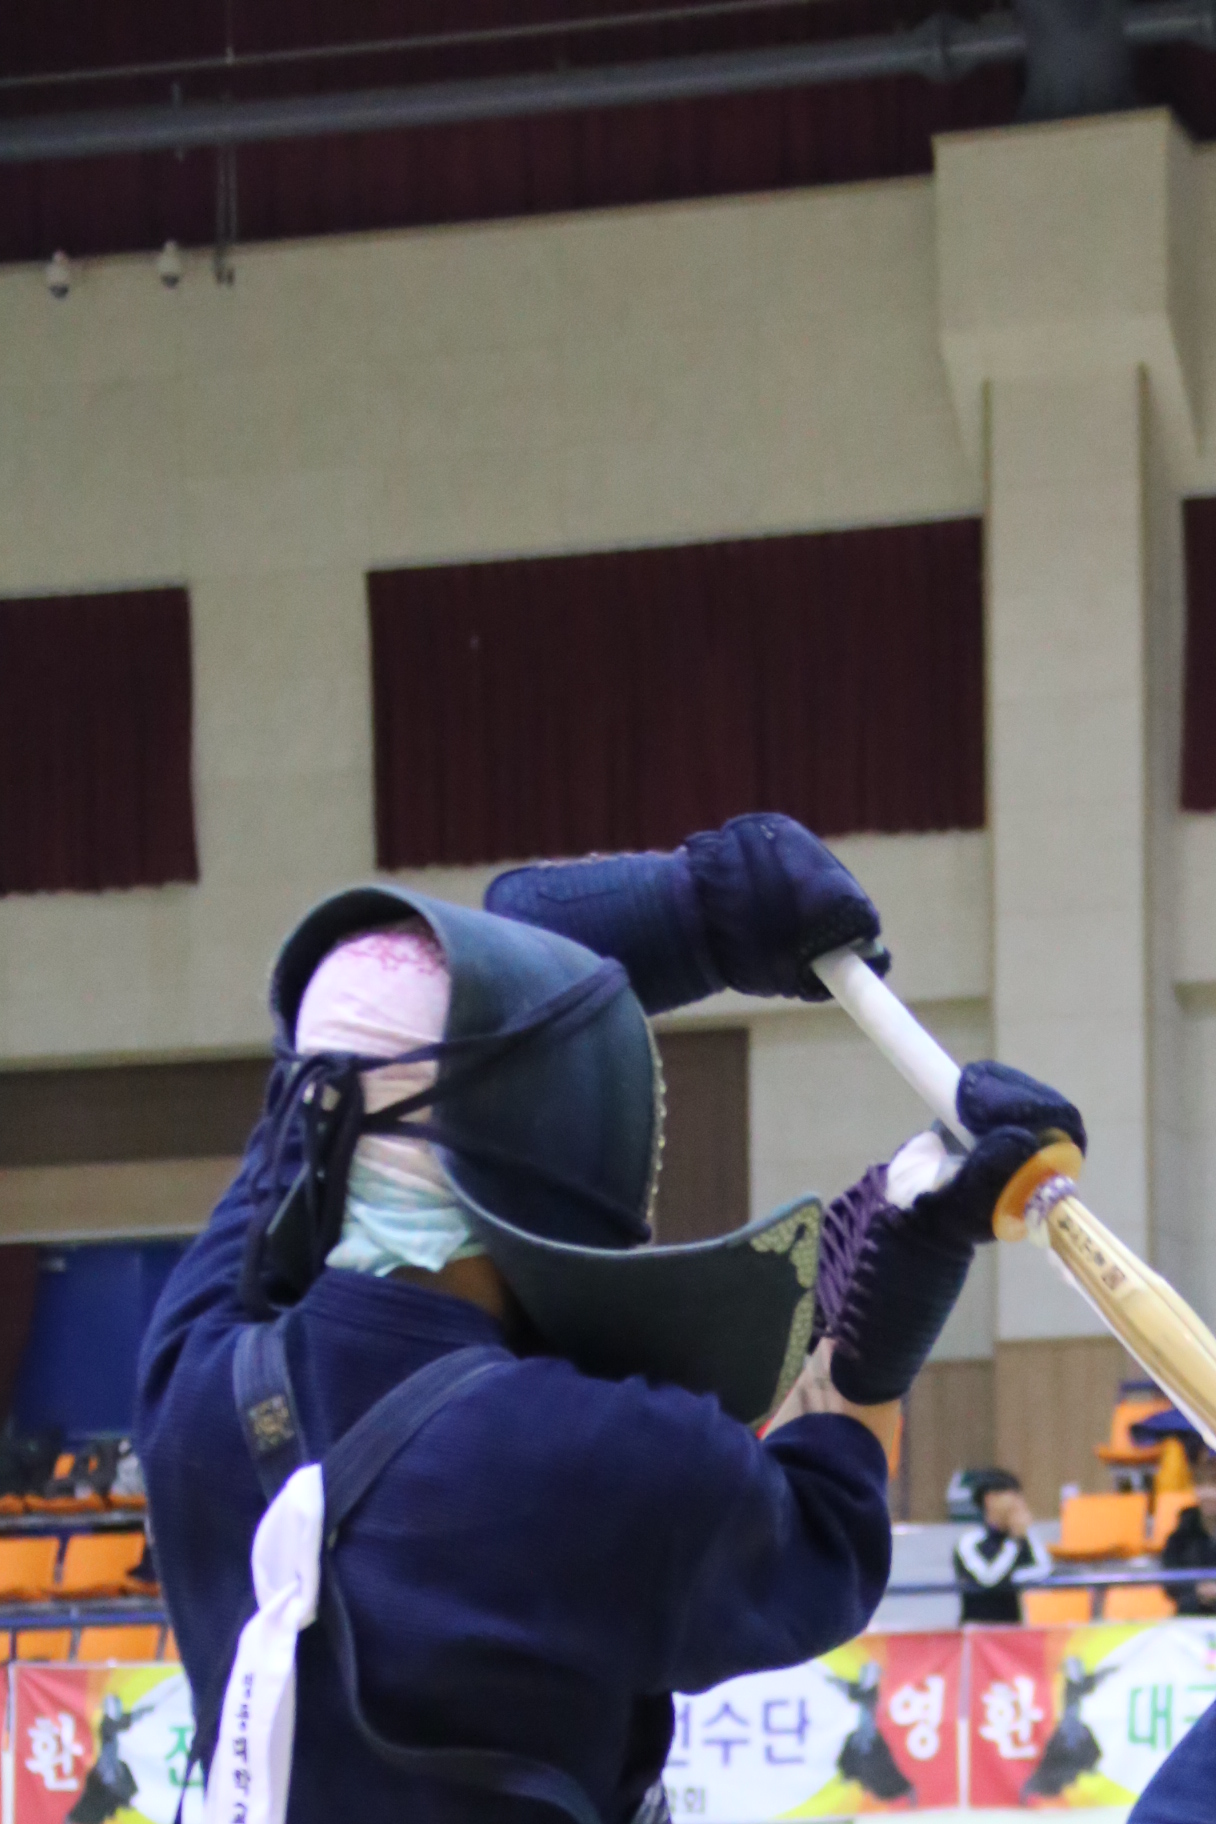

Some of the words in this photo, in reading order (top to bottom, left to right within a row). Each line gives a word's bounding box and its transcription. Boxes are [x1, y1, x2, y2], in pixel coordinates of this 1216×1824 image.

[25, 1712, 83, 1792] 환
[888, 1674, 946, 1761] 영
[979, 1674, 1044, 1760] 환
